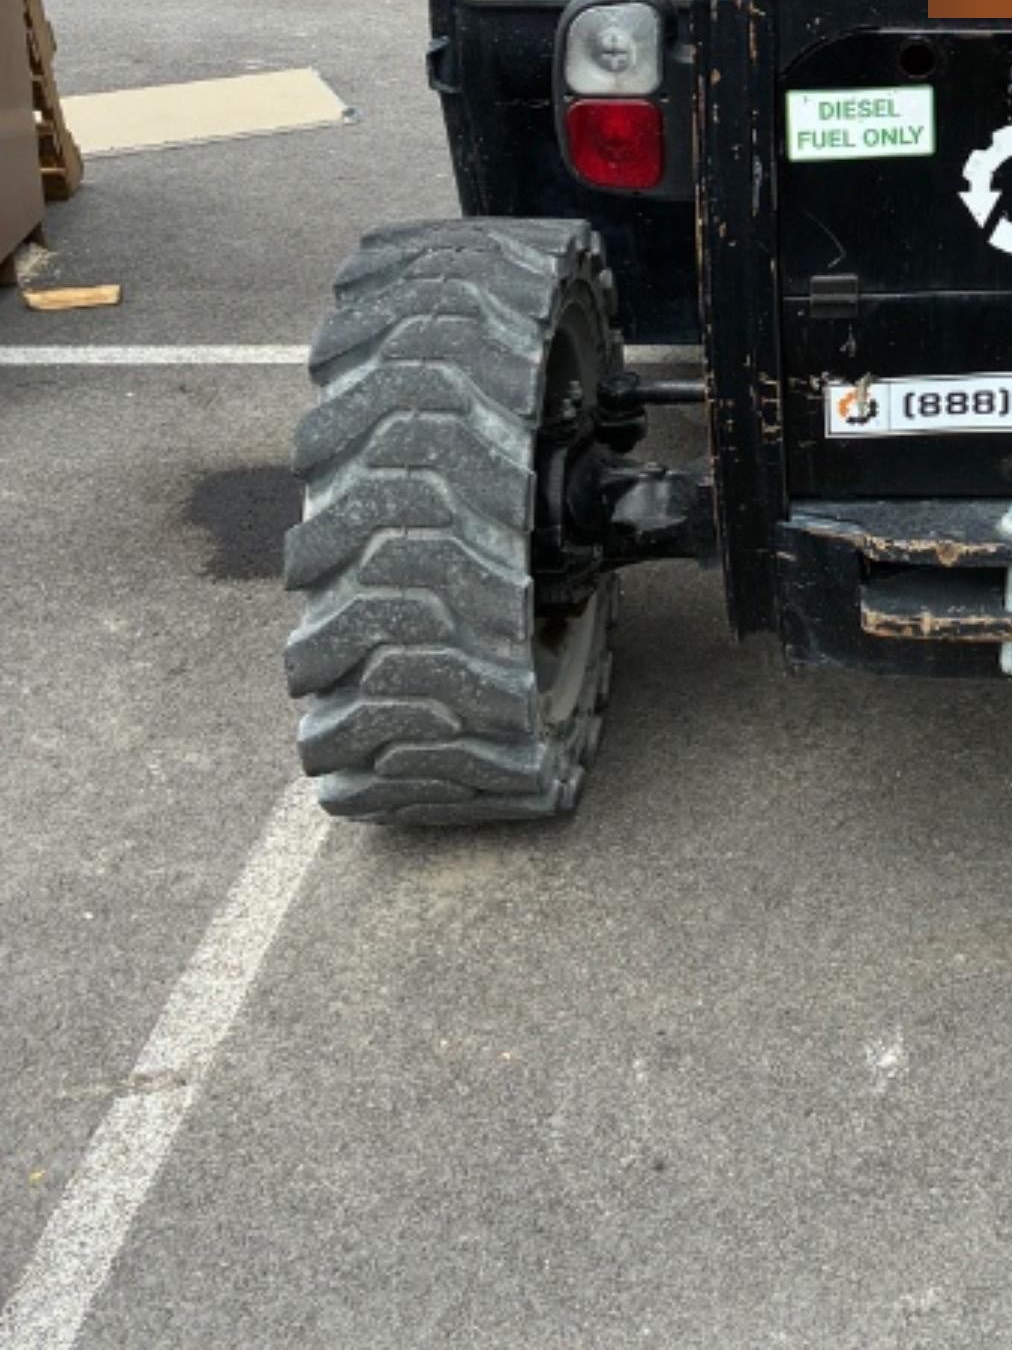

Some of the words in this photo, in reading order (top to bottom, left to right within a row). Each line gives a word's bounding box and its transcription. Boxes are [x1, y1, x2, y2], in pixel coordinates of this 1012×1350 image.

[818, 98, 901, 121] DIESEL
[797, 128, 856, 150] FUEL
[863, 125, 924, 148] ONLY
[903, 389, 1009, 419] (888)
